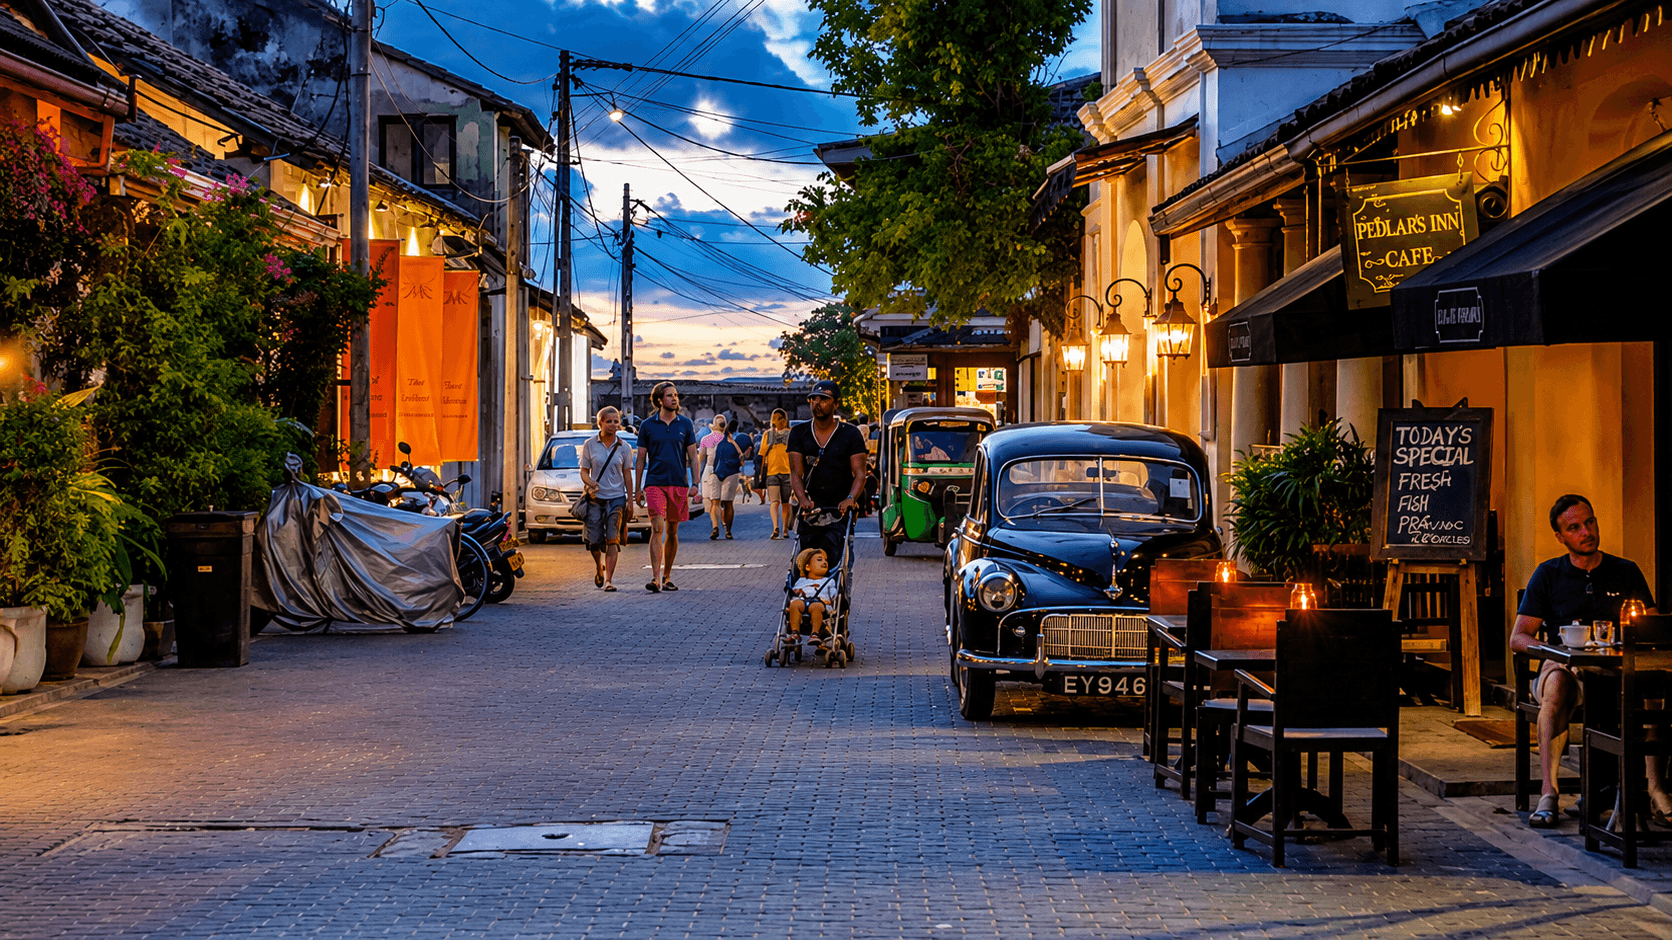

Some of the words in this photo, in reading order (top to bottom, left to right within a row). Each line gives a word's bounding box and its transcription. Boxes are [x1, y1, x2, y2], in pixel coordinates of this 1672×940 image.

[1356, 214, 1427, 240] PEDLAR'S
[1429, 212, 1460, 232] INN
[1385, 246, 1434, 268] CAFE
[1396, 425, 1473, 445] TODAY'S
[1393, 446, 1474, 467] SPECIAL
[1398, 470, 1452, 491] FRESH
[1397, 495, 1430, 513] FISH
